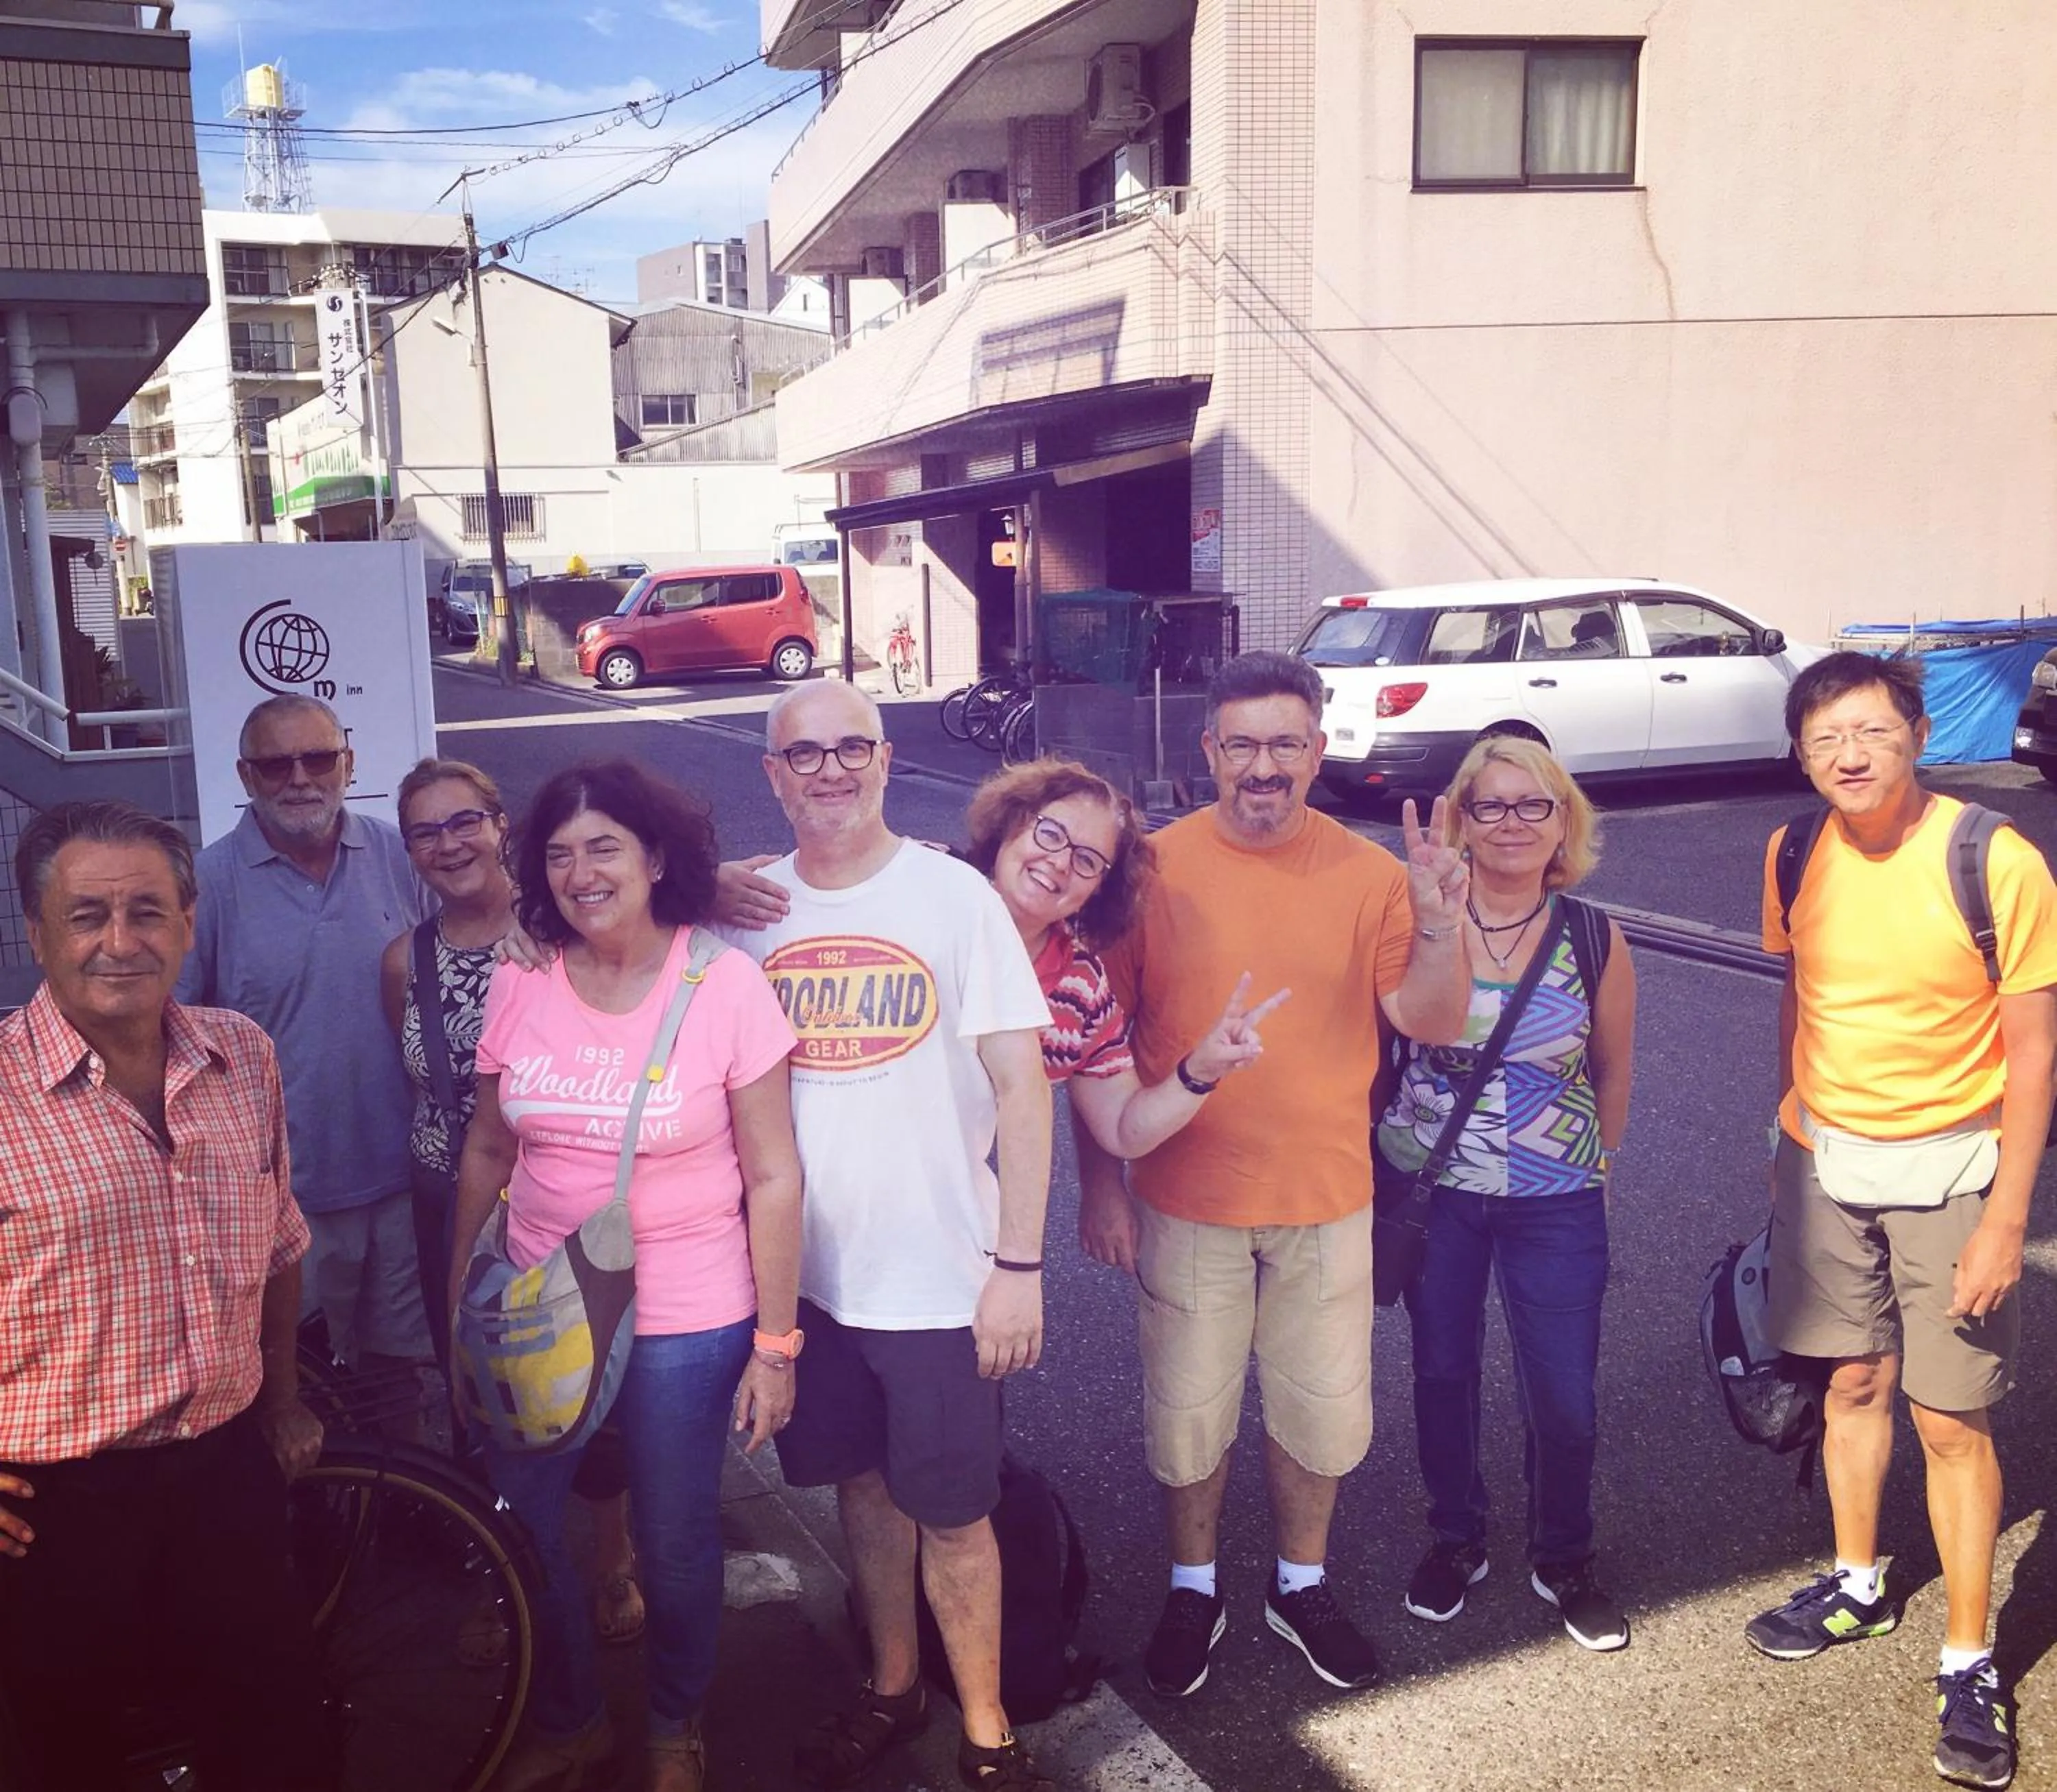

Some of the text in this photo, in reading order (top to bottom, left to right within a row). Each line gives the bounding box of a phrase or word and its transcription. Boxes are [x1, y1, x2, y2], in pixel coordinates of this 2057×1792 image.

[328, 332, 348, 415] サンセオン
[816, 950, 847, 966] 1992
[769, 973, 926, 1029] OODLAND
[575, 1045, 625, 1065] 1992
[805, 1039, 863, 1058] GEAR
[509, 1054, 682, 1104] Woodlad
[585, 1118, 683, 1141] ACIVE
